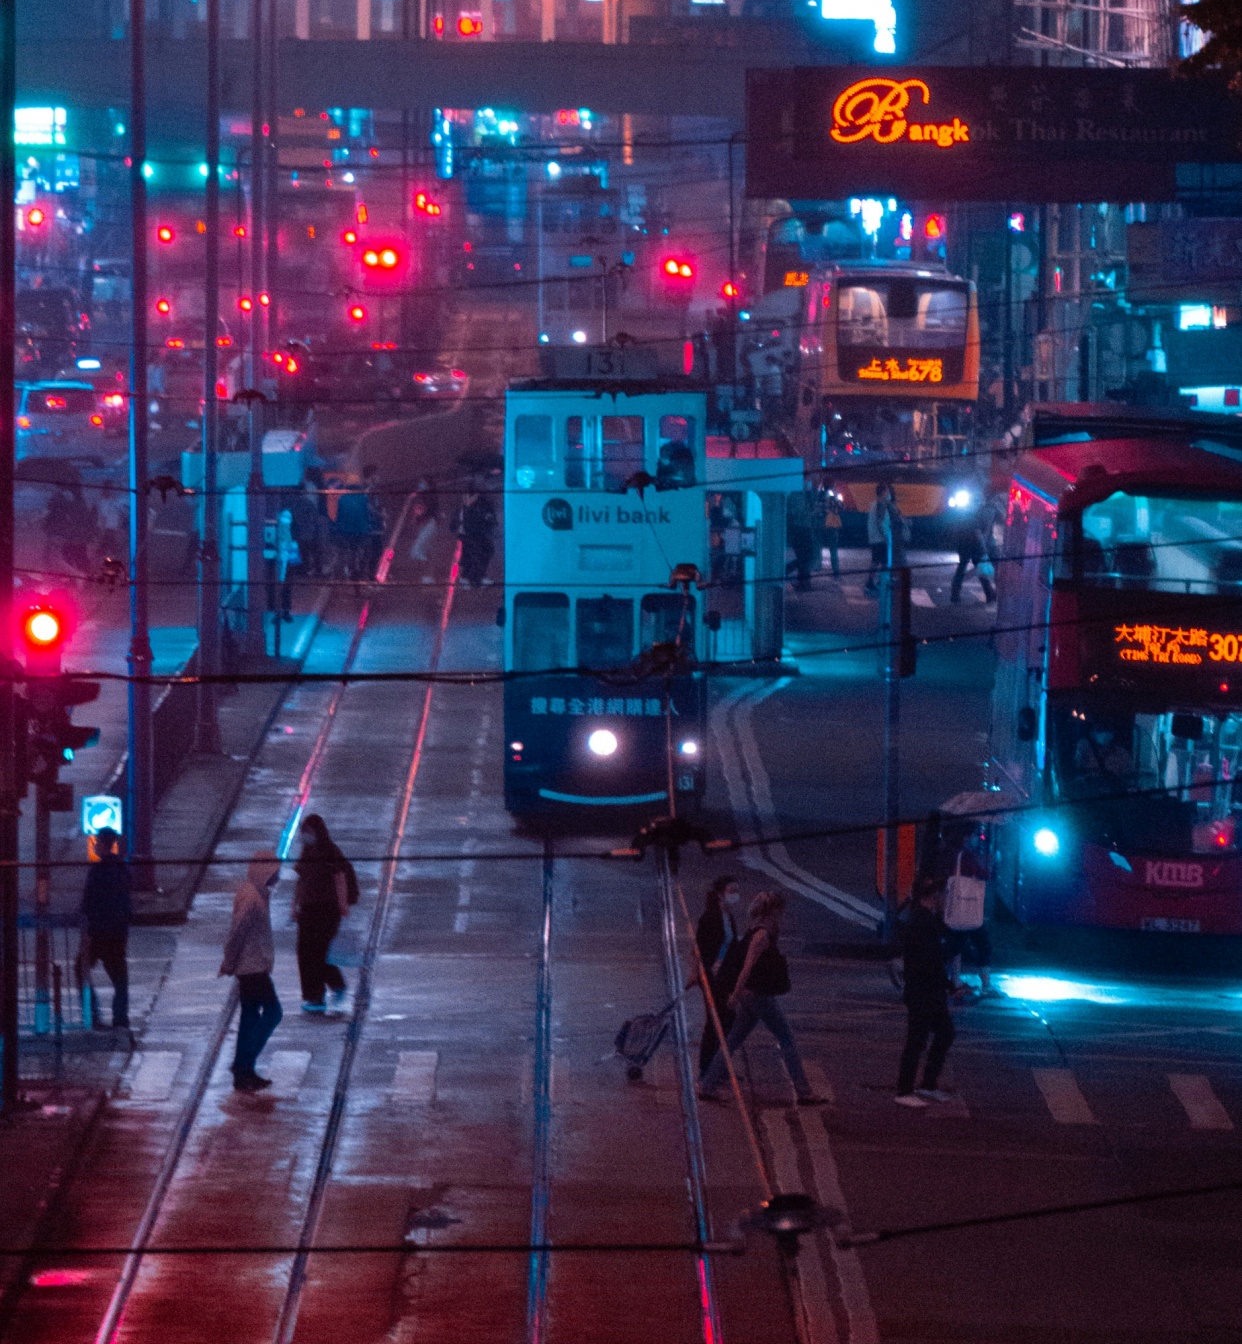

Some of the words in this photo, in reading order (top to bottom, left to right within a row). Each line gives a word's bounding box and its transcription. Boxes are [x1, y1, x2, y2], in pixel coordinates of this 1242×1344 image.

[1009, 118, 1066, 141] Thai
[586, 351, 626, 375] 131
[908, 365, 943, 382] 678
[578, 506, 610, 524] livi
[617, 506, 671, 524] bank
[1145, 861, 1203, 887] KMB
